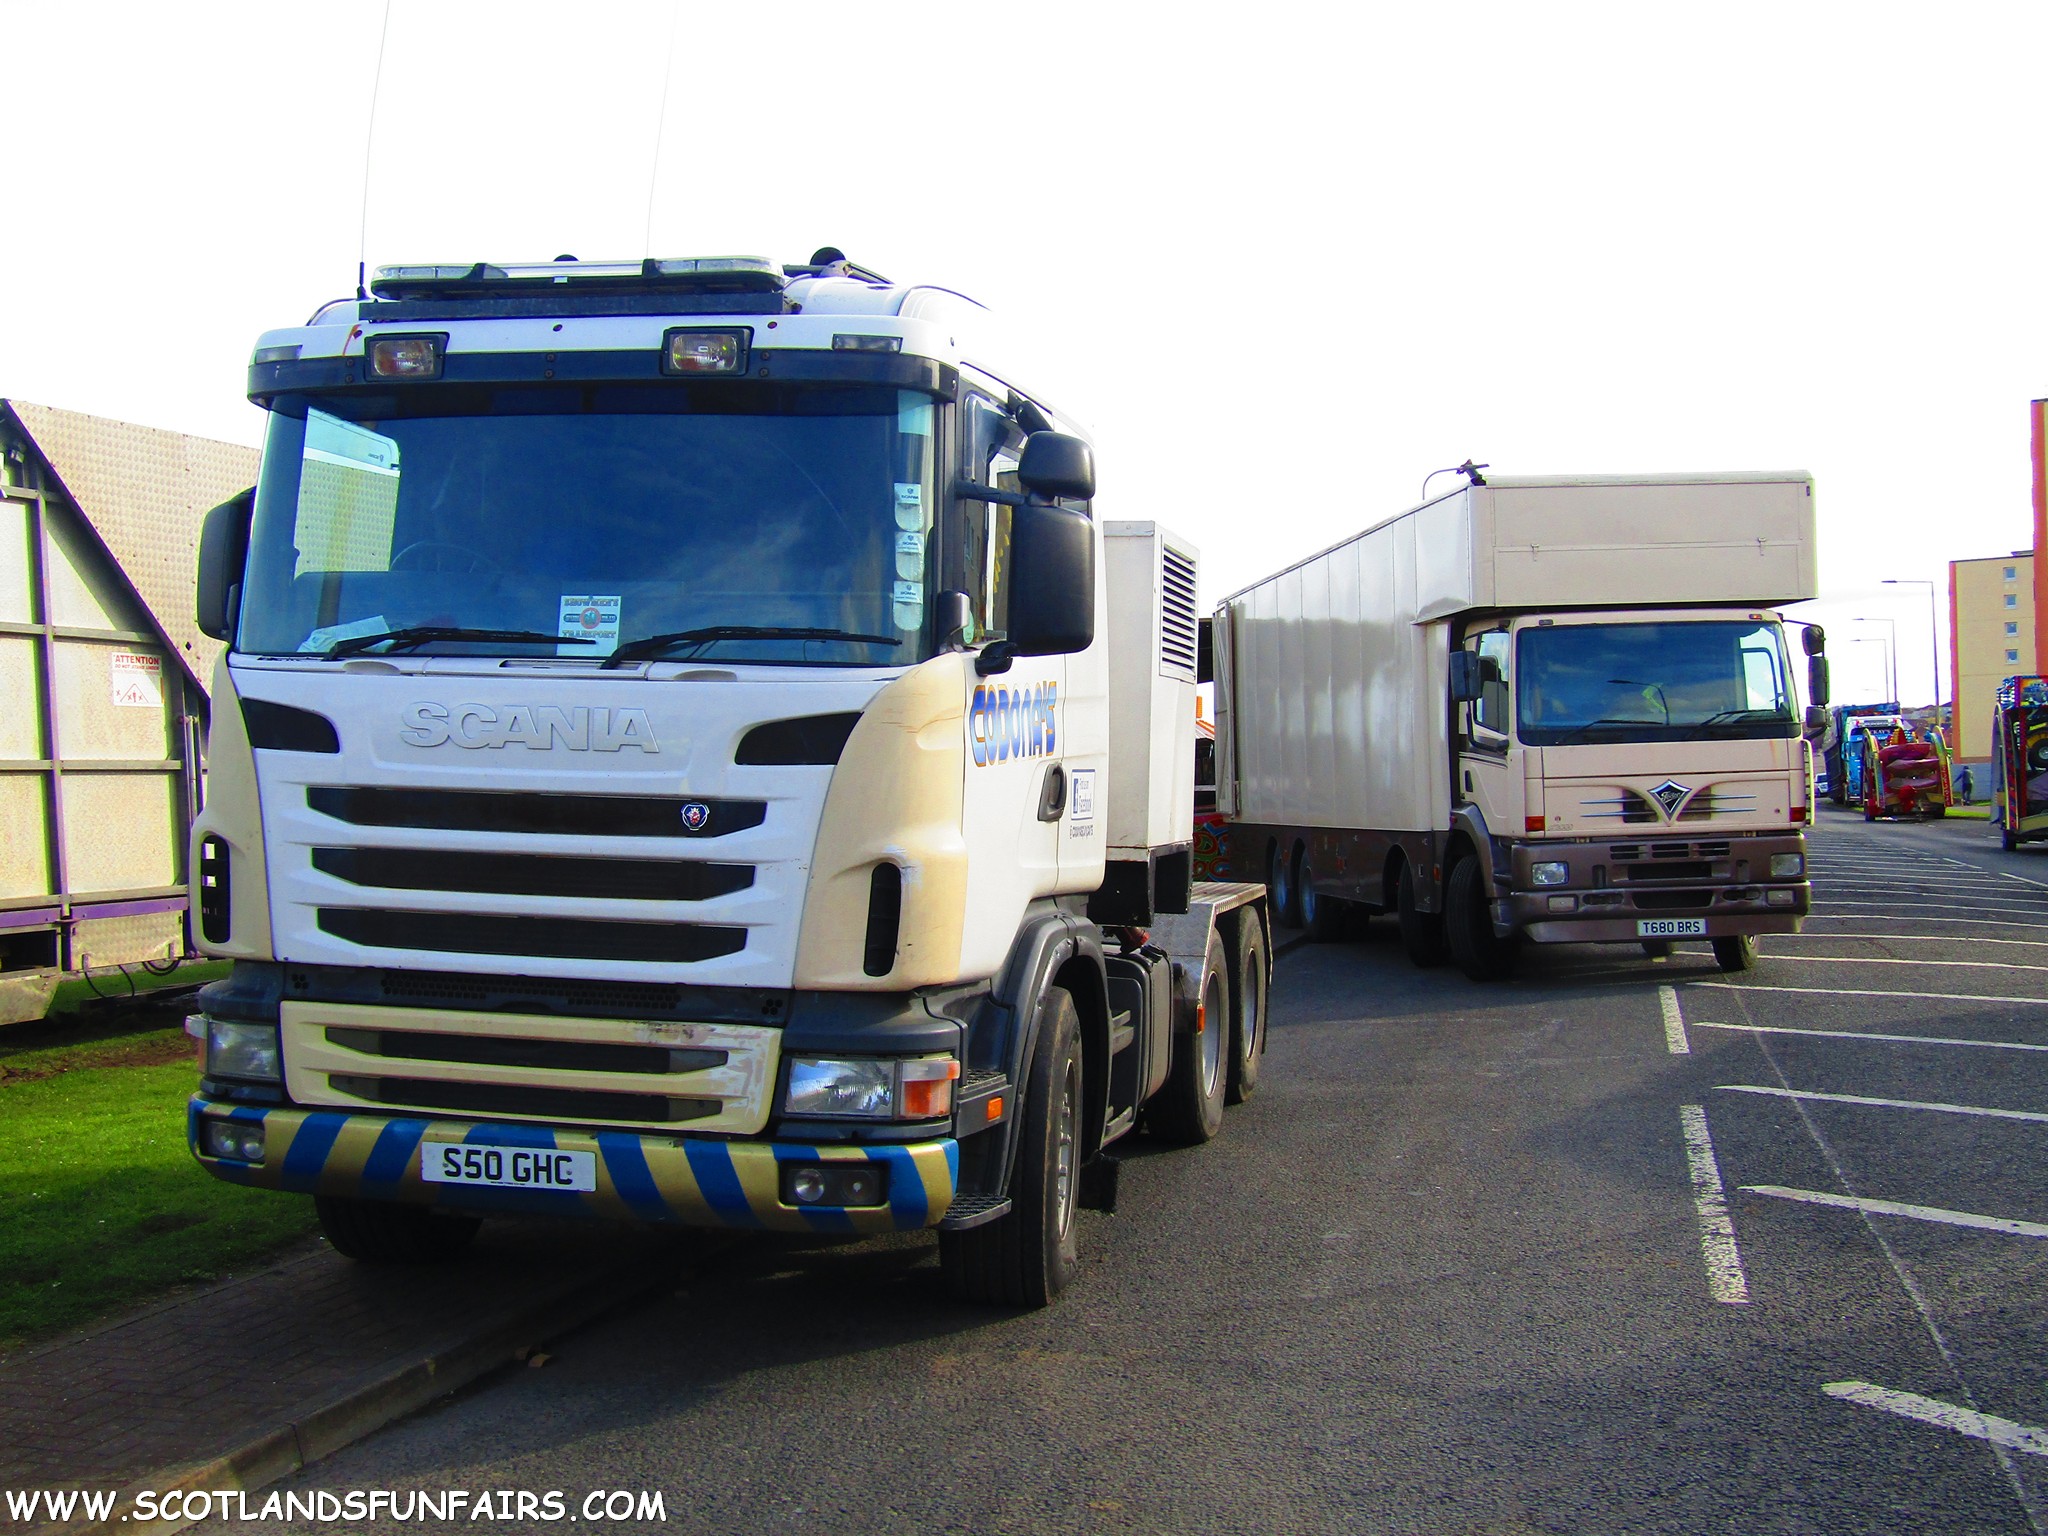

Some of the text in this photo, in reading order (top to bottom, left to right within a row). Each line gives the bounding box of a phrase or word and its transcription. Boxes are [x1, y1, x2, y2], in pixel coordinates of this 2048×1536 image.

[115, 655, 160, 665] ATTENTION
[399, 701, 660, 753] SCANIA
[1642, 921, 1700, 934] T680 BRS
[443, 1147, 573, 1185] S50 GHC
